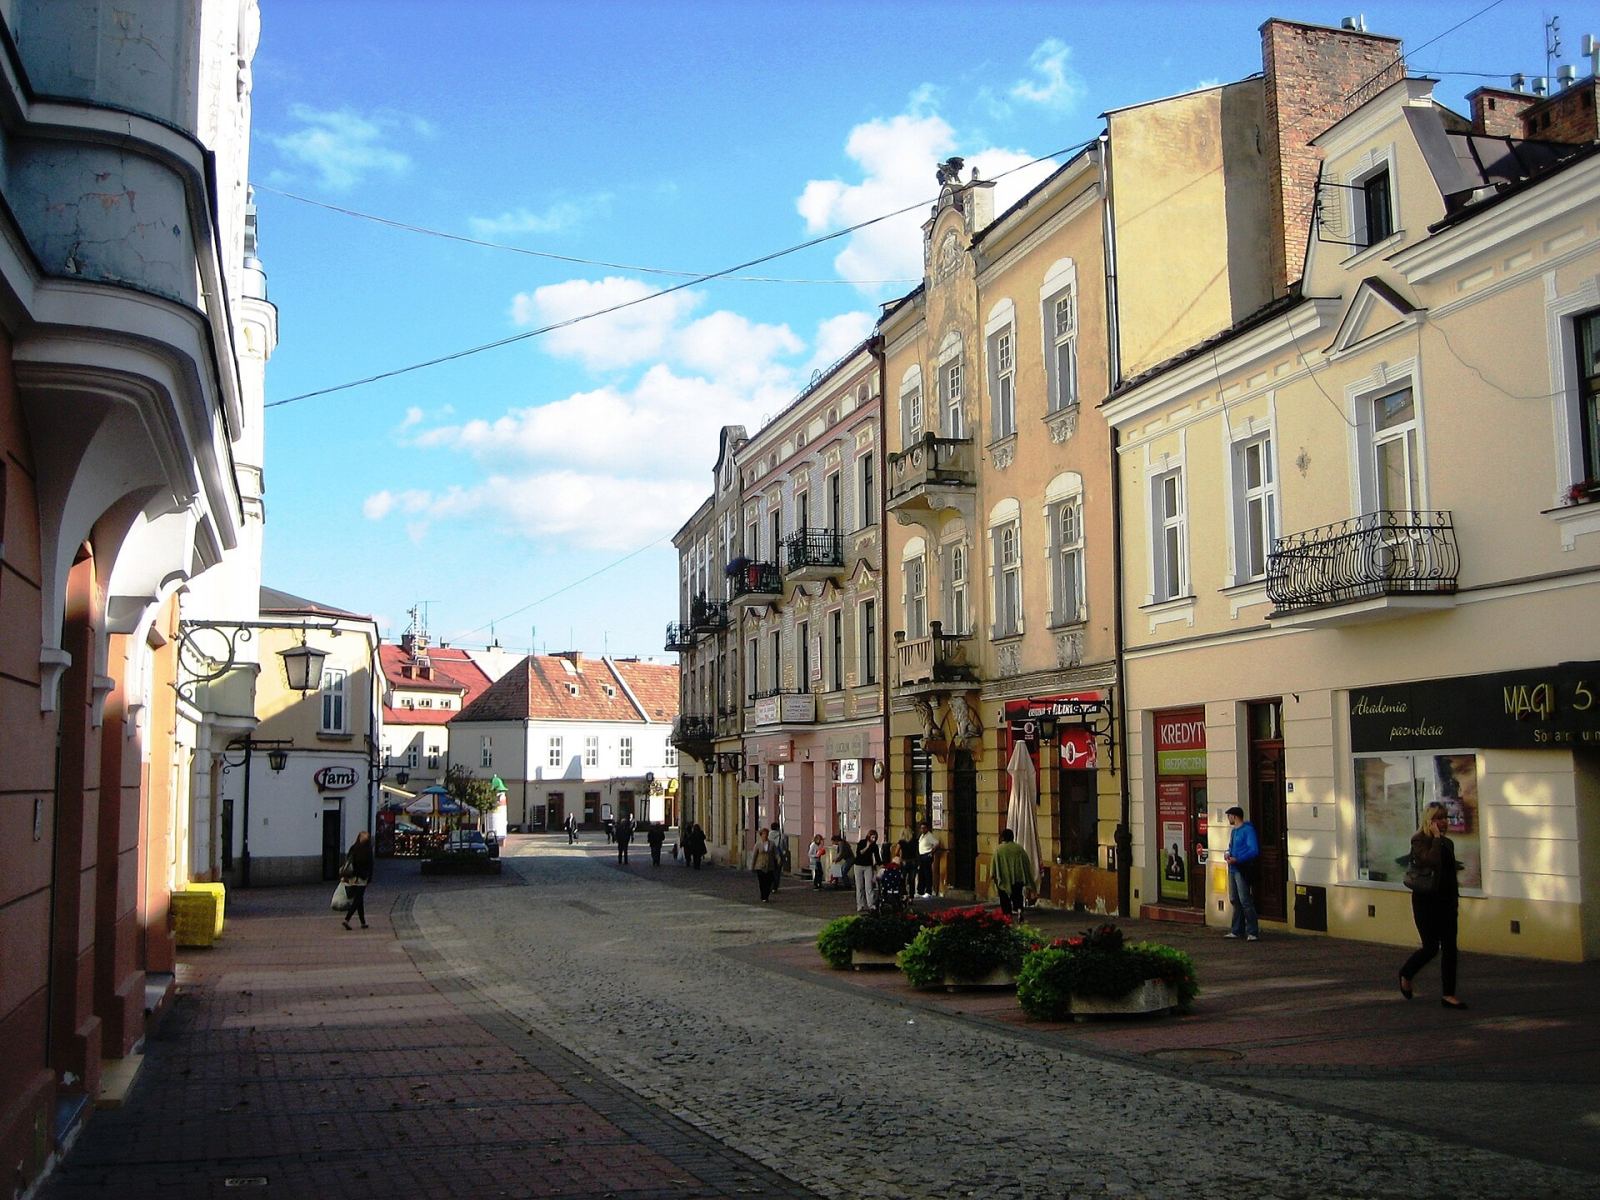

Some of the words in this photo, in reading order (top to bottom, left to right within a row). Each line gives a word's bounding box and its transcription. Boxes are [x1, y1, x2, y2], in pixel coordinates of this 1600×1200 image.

[1352, 696, 1407, 715] Akademia
[1389, 717, 1443, 740] paznokcia
[321, 767, 355, 788] fami
